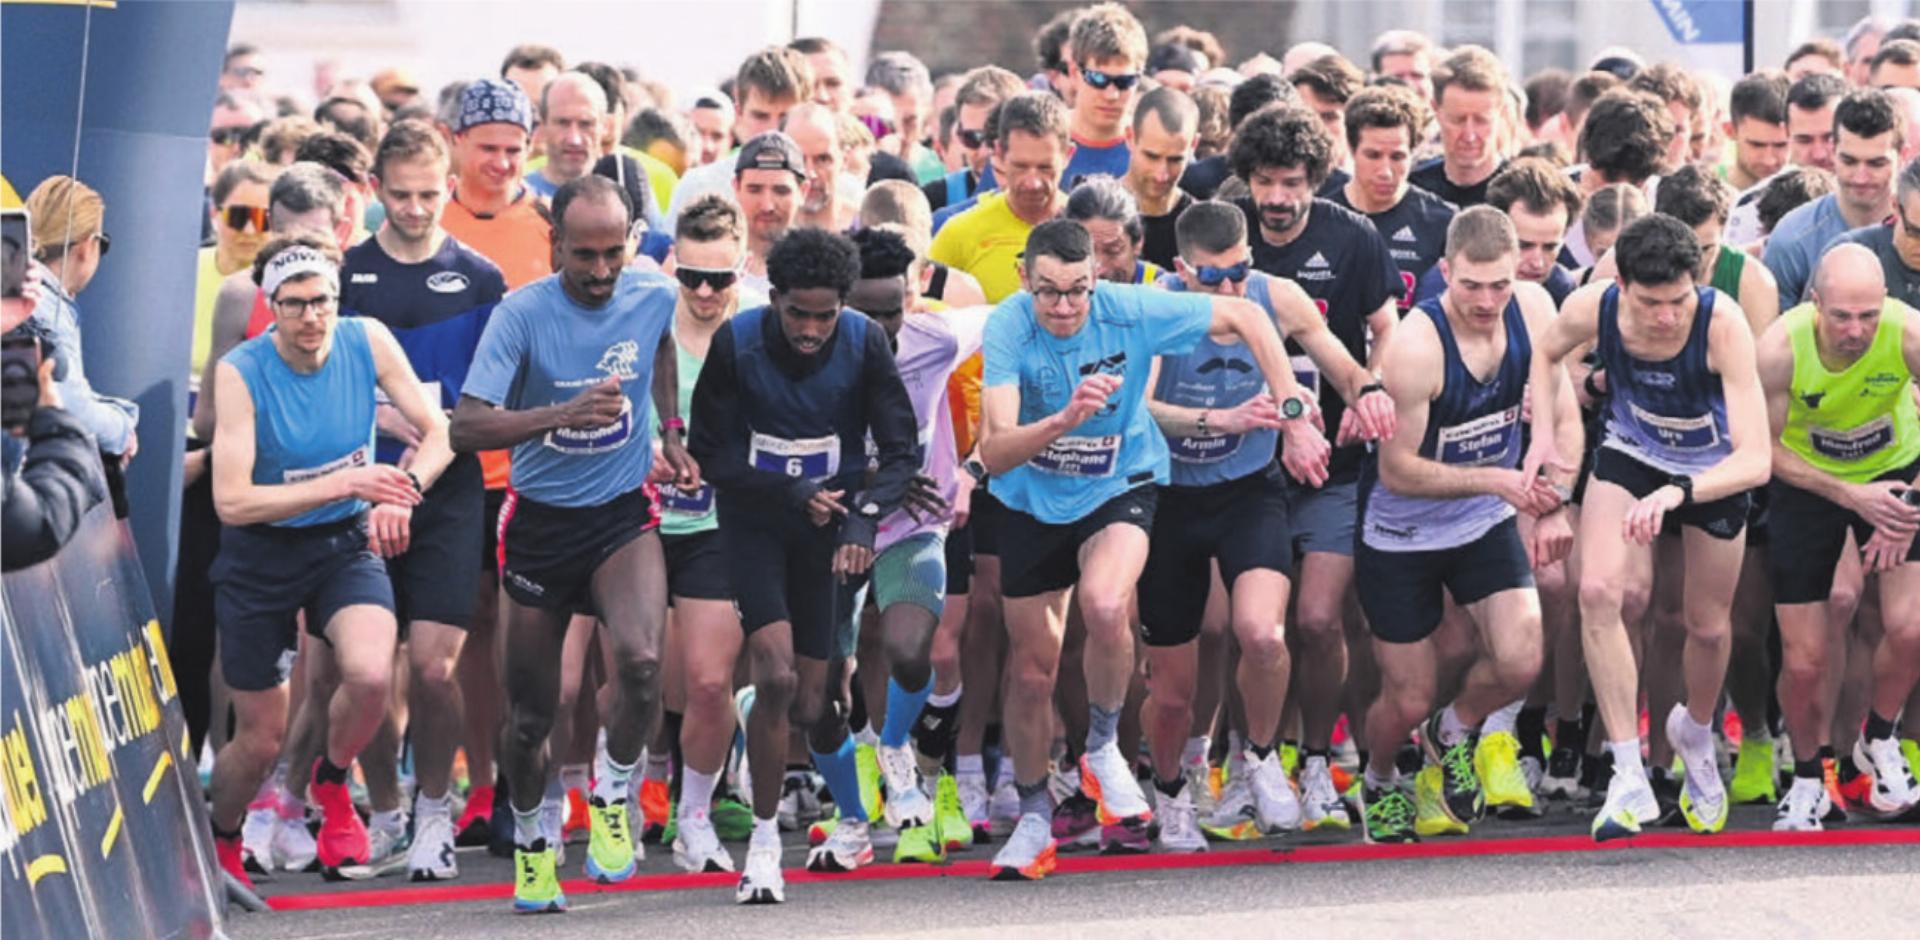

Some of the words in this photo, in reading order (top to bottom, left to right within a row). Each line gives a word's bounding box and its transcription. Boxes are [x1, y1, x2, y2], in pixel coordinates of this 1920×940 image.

[1181, 437, 1227, 450] Armin
[1458, 433, 1503, 455] Stefan
[786, 457, 803, 478] 6
